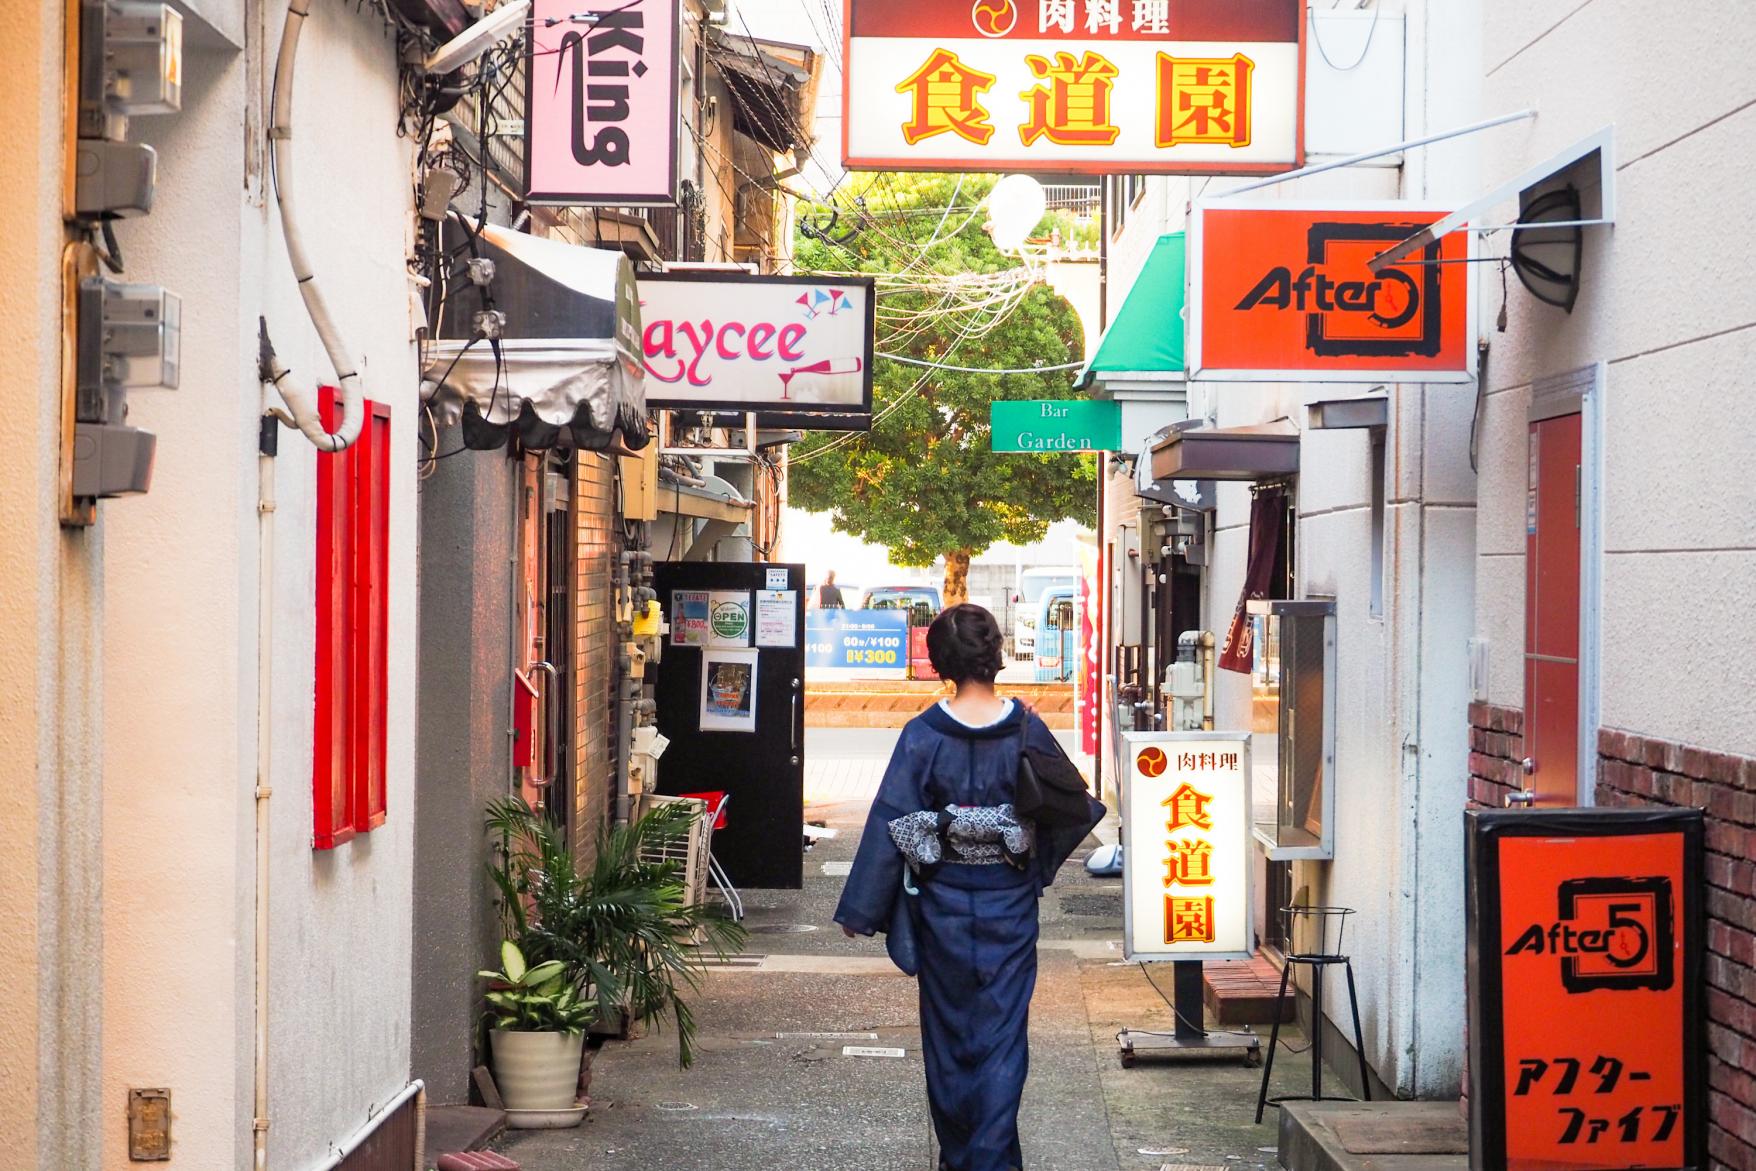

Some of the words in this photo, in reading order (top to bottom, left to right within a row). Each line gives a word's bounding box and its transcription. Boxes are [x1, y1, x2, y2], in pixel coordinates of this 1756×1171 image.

[1038, 0, 1170, 34] 肉料理
[556, 10, 649, 167] King
[895, 47, 1256, 149] 食道園
[1233, 266, 1382, 311] After
[642, 318, 807, 386] aycee
[1040, 402, 1069, 417] Bar
[1017, 432, 1091, 449] Garden
[713, 612, 745, 621] OPEN
[1177, 752, 1239, 771] 肉料理
[1161, 782, 1215, 944] 食道園
[1504, 922, 1616, 955] After
[1514, 1055, 1652, 1096] アフター
[1557, 1104, 1681, 1144] ファイブ
